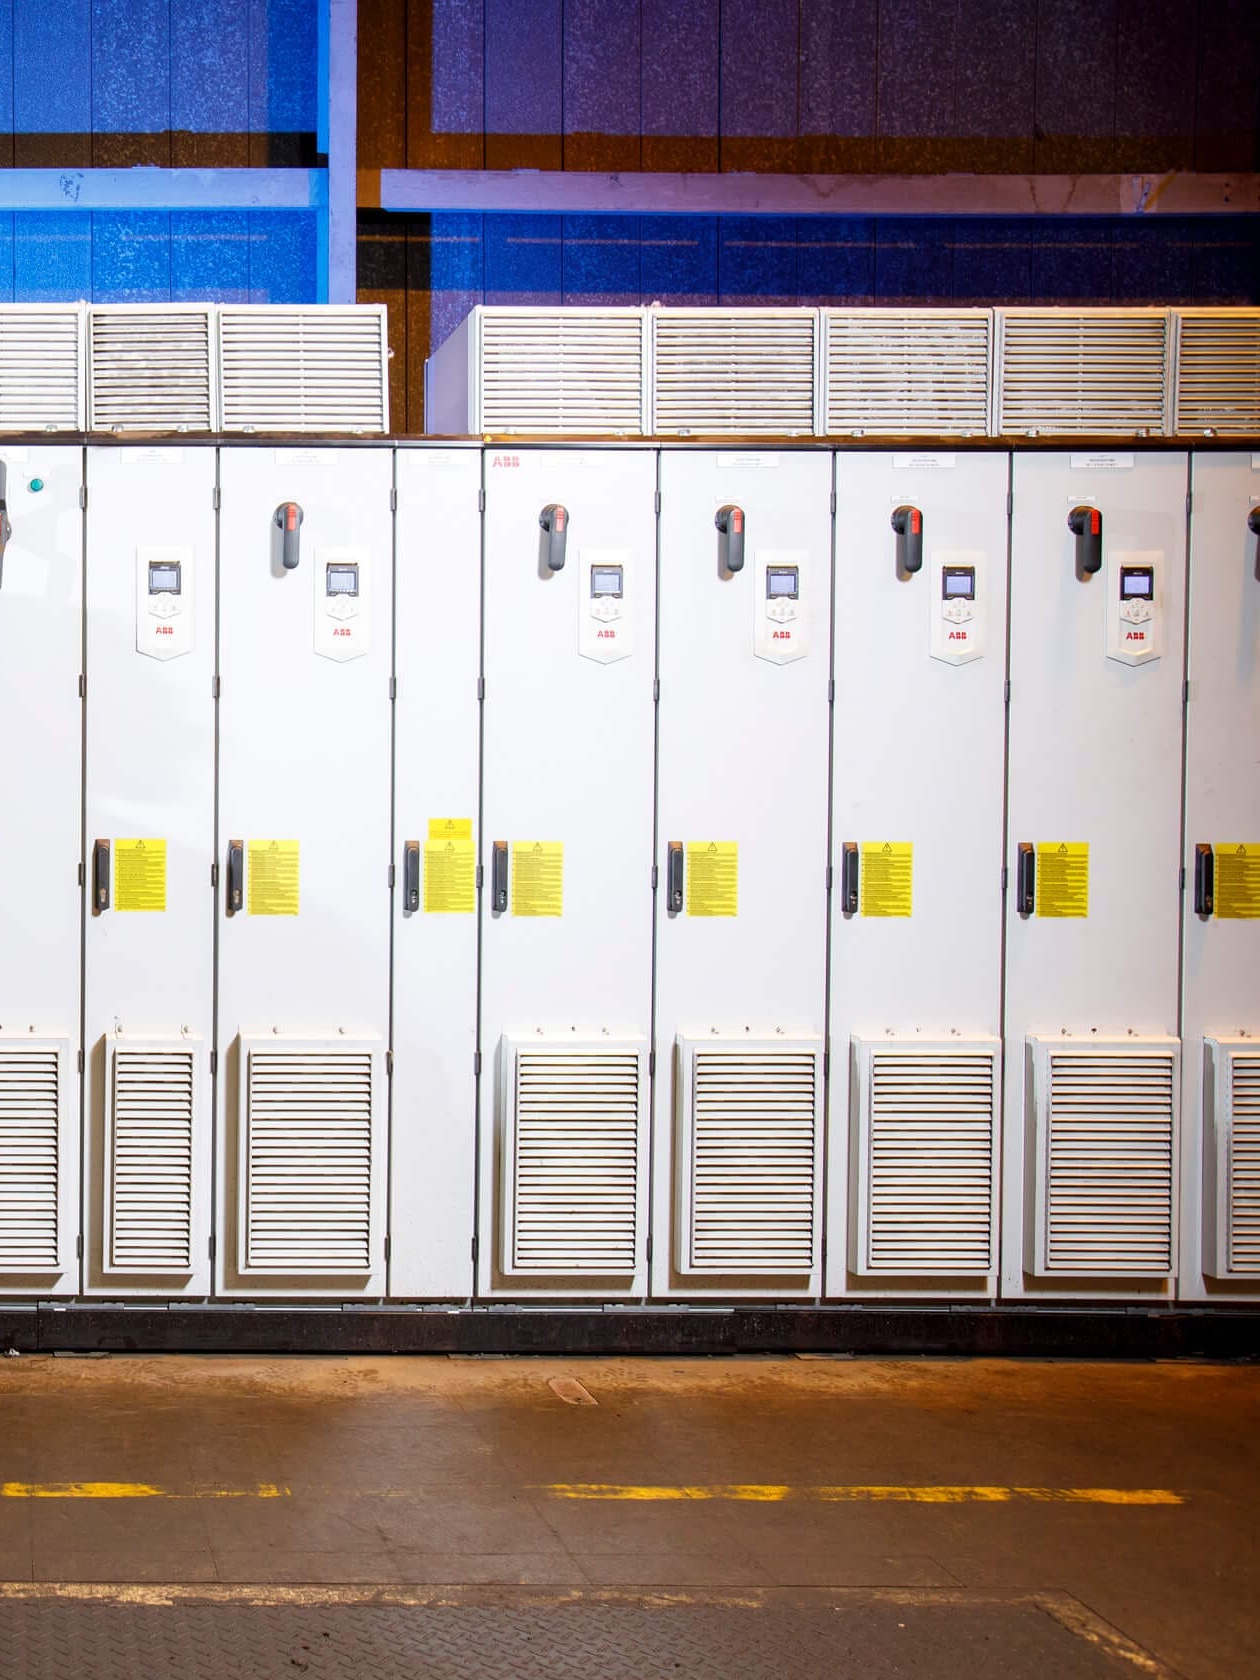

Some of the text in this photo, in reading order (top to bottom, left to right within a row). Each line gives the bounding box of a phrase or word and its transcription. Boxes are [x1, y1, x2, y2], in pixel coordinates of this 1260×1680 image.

[493, 456, 521, 468] ABB
[155, 626, 174, 635] ABB
[333, 628, 352, 636] ABB
[597, 630, 616, 638] ABB
[772, 631, 791, 640] ABB
[948, 631, 968, 640] ABB
[1126, 632, 1146, 640] ABB
